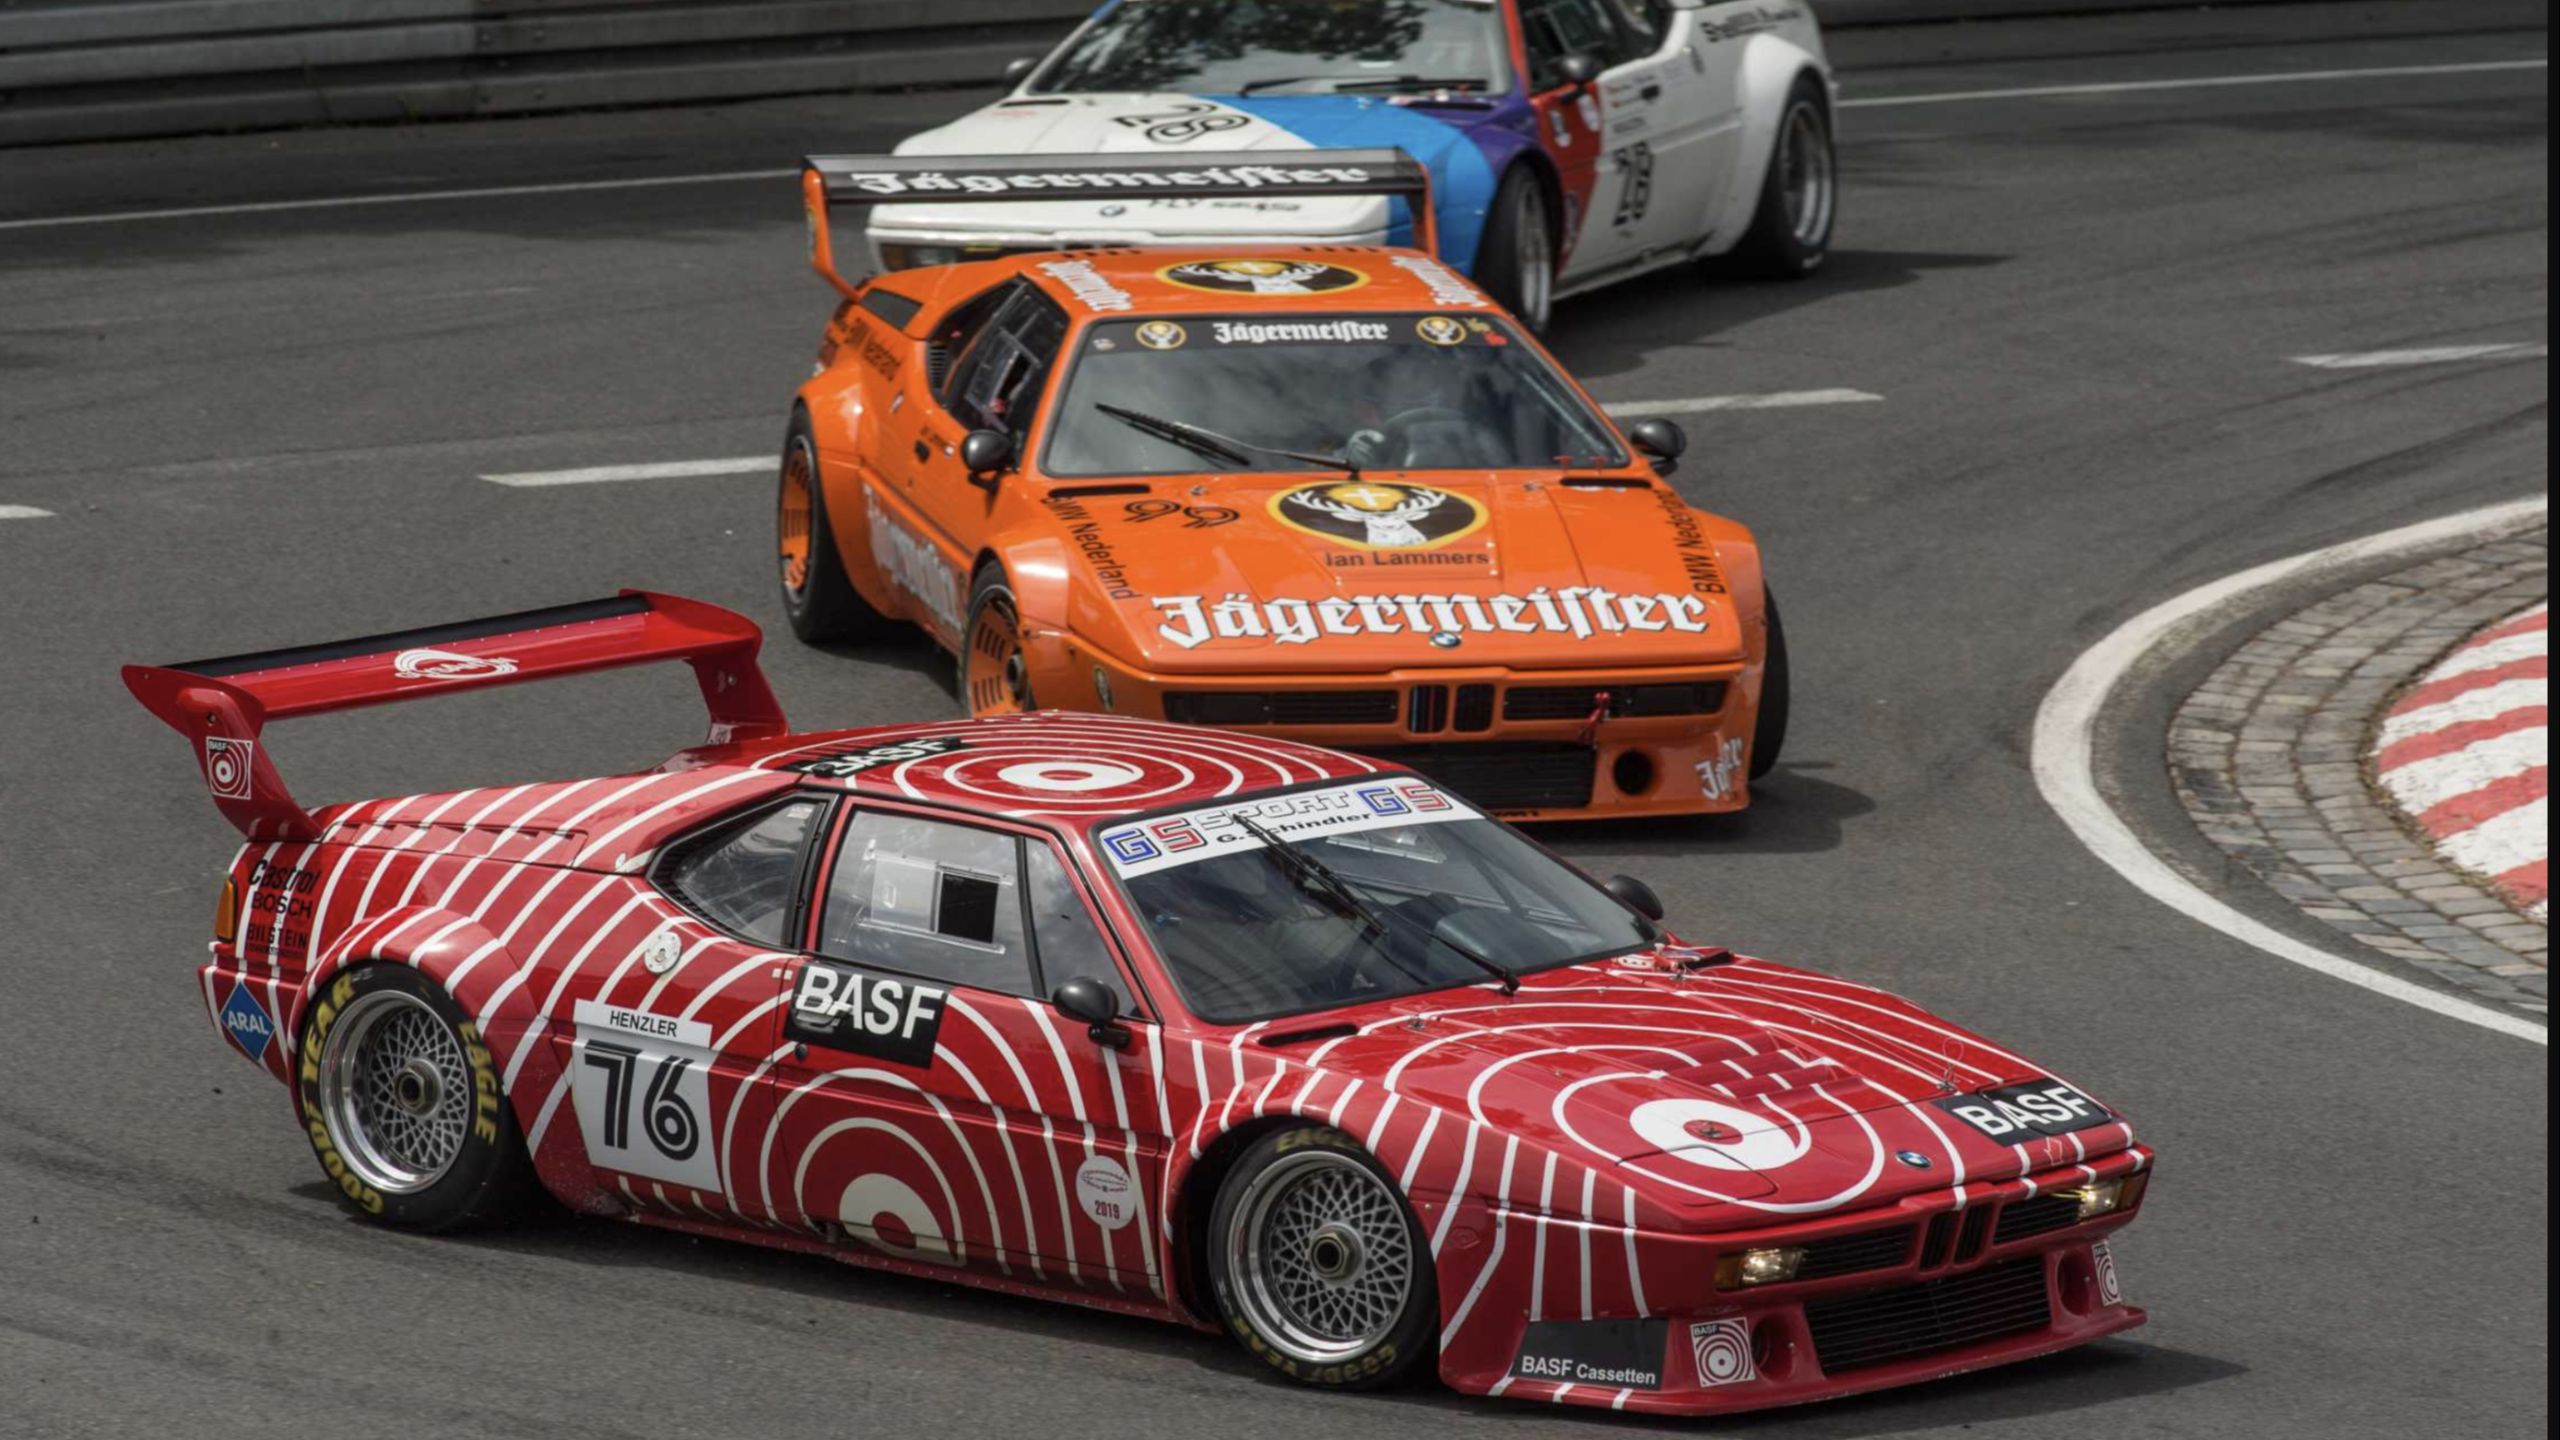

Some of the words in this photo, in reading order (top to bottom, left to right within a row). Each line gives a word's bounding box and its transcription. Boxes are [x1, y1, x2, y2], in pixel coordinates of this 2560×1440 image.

[851, 169, 1369, 195] Jägermeister
[1612, 141, 1655, 226] 28
[1212, 320, 1389, 344] Jägermeister
[1067, 522, 1144, 600] Nederland
[1372, 551, 1490, 567] Lammers
[1678, 552, 1726, 594] BMW
[1152, 585, 1708, 649] Jägermeister
[801, 739, 946, 775] BASF
[1196, 791, 1351, 831] SPORT
[249, 859, 321, 893] Castrol
[252, 890, 312, 918] BOSCH
[247, 922, 308, 950] BILSTEIN
[794, 965, 945, 1040] BASF
[227, 1010, 269, 1037] ARAL
[610, 1010, 678, 1038] HENZLER
[458, 1021, 498, 1146] EAGLE
[584, 1038, 699, 1161] 76
[1951, 1086, 2090, 1136] BASF
[1094, 1200, 1120, 1220] 2019
[1694, 1324, 1719, 1337] BASF
[1521, 1355, 1573, 1377] BASF
[1576, 1363, 1656, 1386] Cassetten
